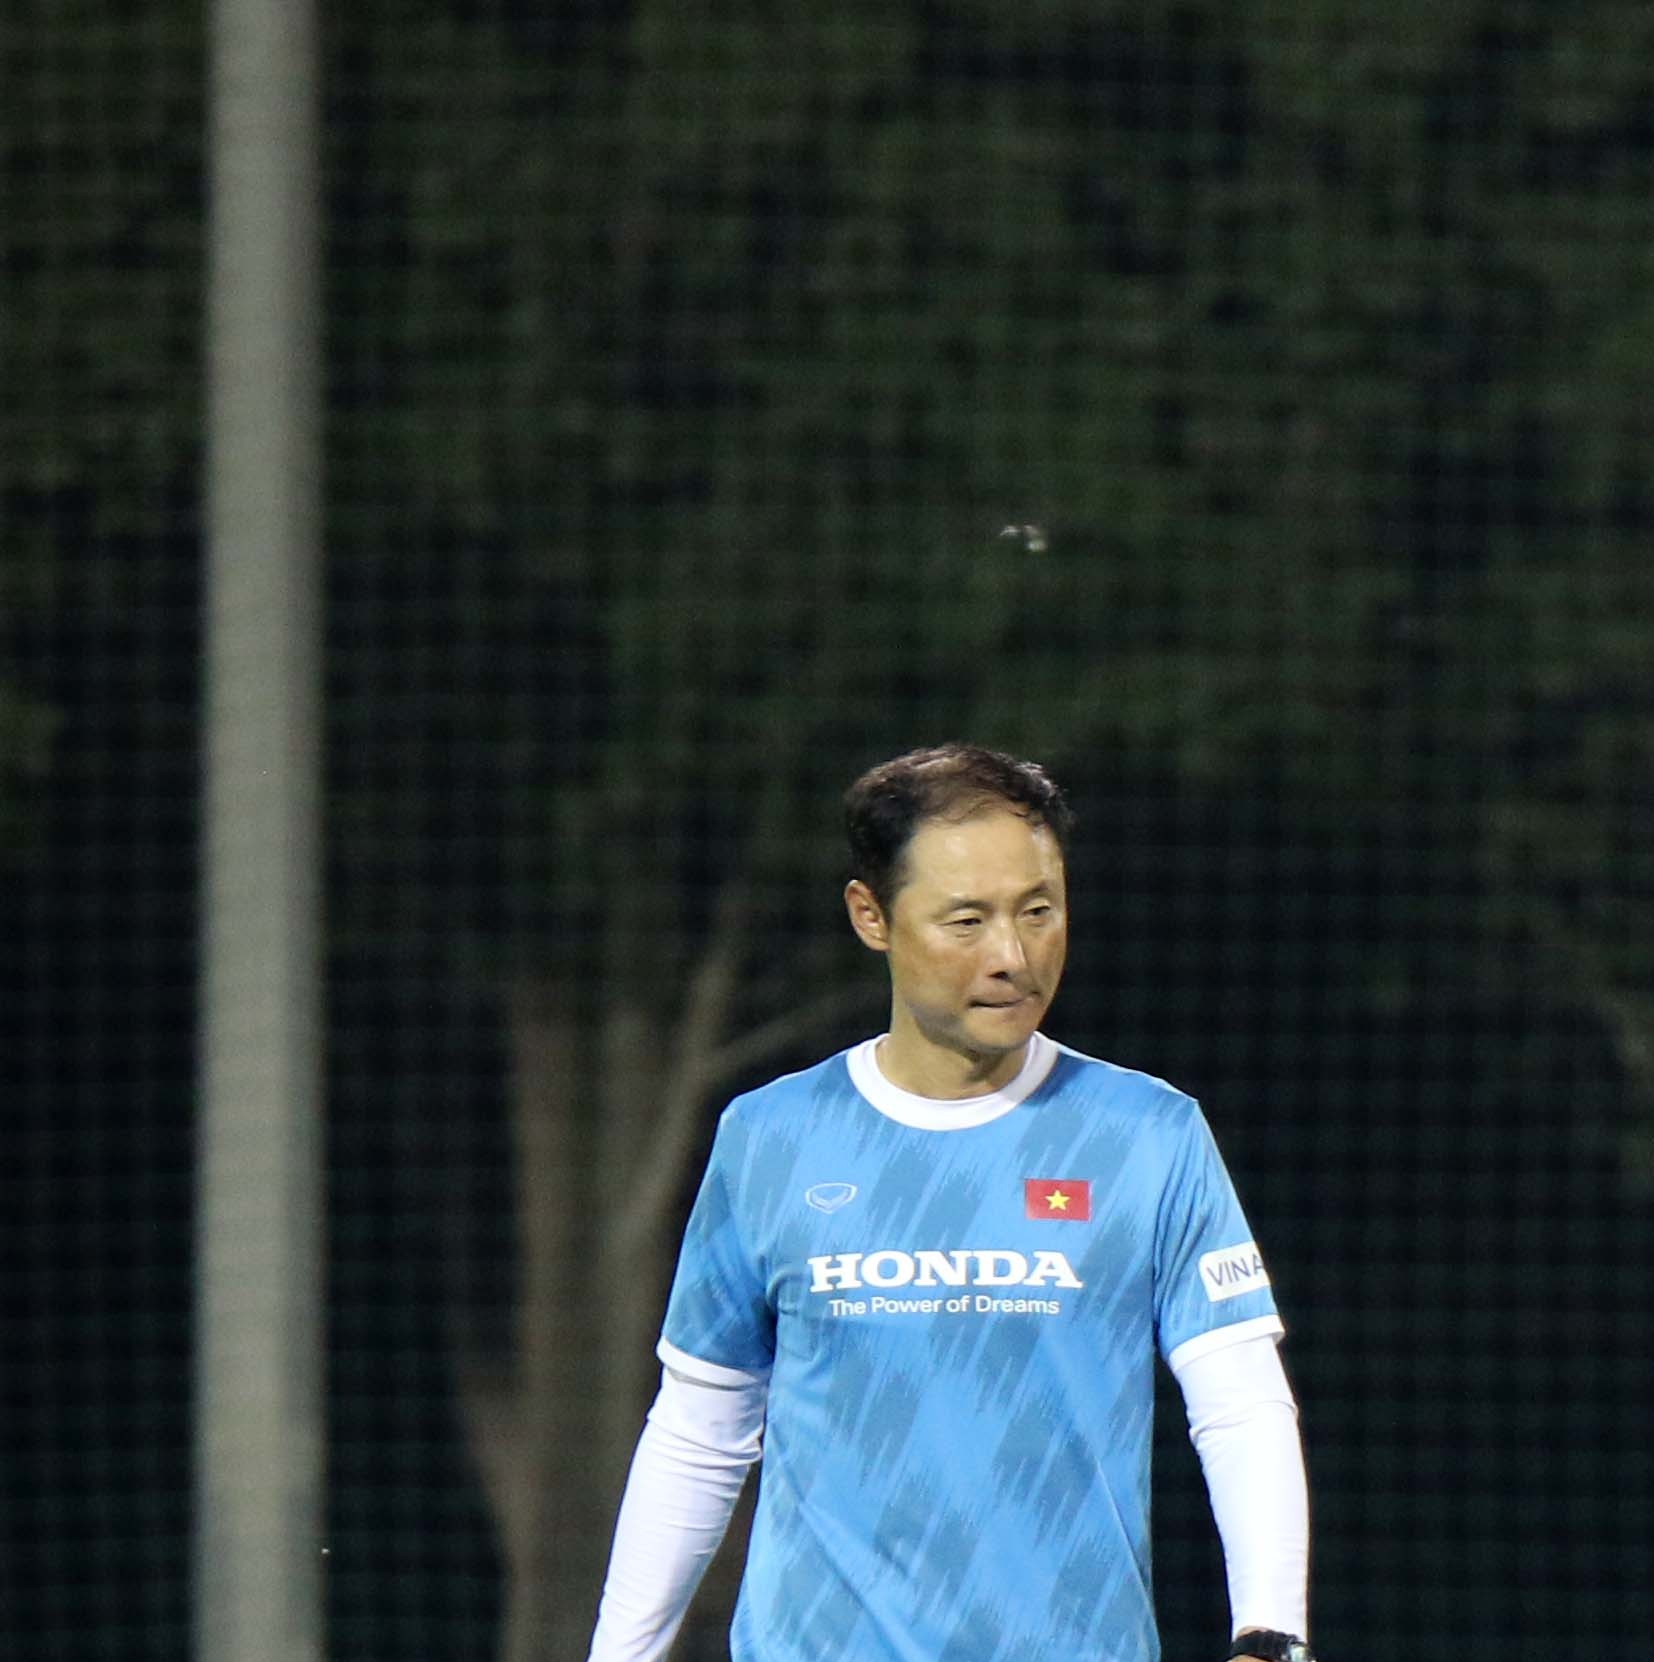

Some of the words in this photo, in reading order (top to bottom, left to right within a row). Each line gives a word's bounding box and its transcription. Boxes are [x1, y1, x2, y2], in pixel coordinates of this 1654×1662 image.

[807, 1249, 1084, 1293] HONDA
[829, 1299, 866, 1317] The
[871, 1296, 939, 1315] Power
[945, 1294, 970, 1313] of
[975, 1295, 1060, 1315] Dreams
